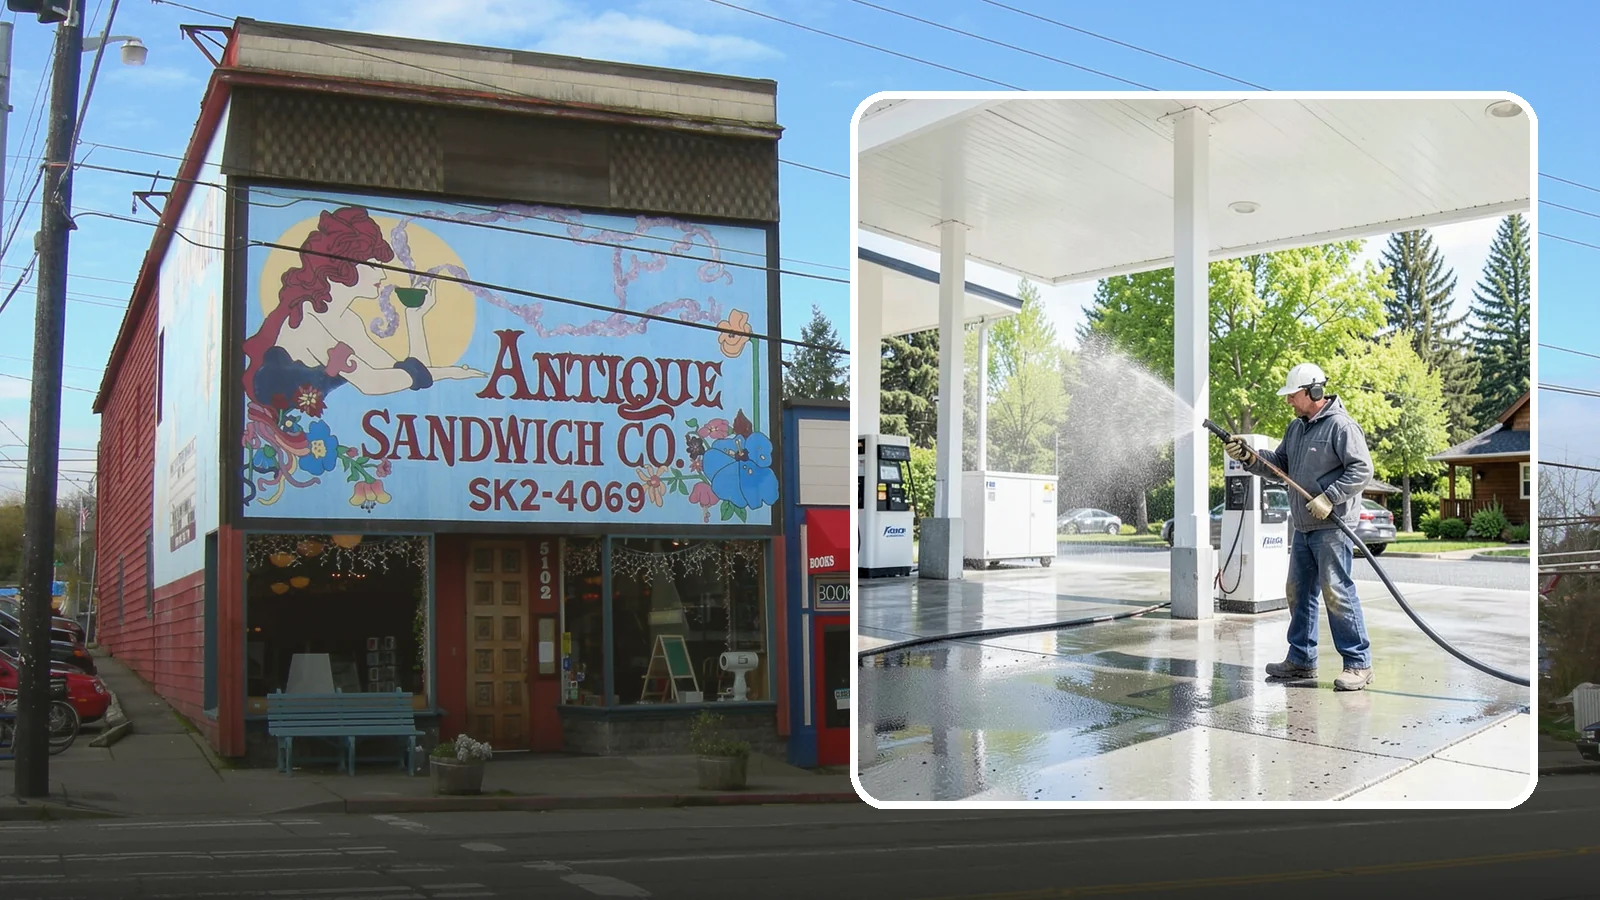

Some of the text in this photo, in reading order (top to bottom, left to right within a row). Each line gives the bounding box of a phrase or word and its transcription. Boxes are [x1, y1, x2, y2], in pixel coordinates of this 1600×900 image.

[476, 329, 723, 420] ANTIQUE
[362, 409, 685, 468] SANDWICH CO.
[469, 478, 646, 513] SK2-4069
[540, 542, 551, 599] 5102
[809, 555, 834, 569] BOOKS
